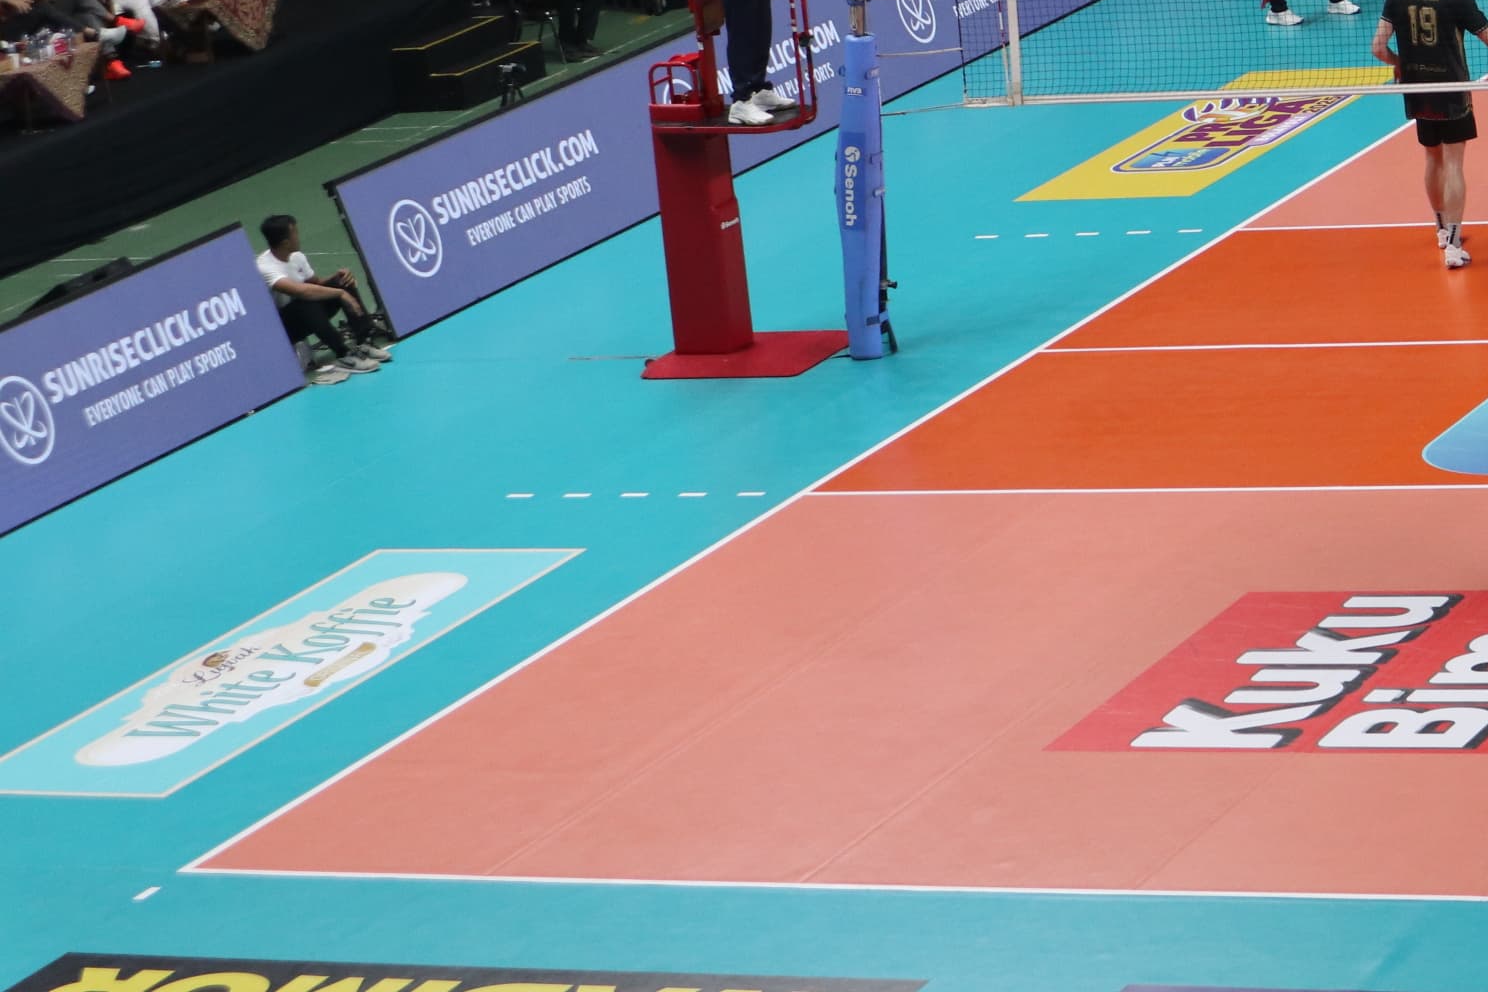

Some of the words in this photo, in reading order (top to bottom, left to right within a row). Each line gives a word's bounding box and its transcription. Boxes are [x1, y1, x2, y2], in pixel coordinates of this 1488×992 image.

[1407, 5, 1438, 46] 19
[1203, 98, 1323, 147] LIGA
[431, 129, 600, 225] SUNRISECLICK.COM
[466, 211, 517, 247] EVERYONE
[515, 204, 536, 225] CAN
[535, 192, 556, 216] PLAY
[556, 175, 592, 206] SPORTS
[844, 164, 858, 227] Senoh
[42, 288, 247, 404] SUNRISECLICK.COM
[84, 387, 145, 428] EVERYONE
[144, 374, 169, 400] CAN
[168, 358, 196, 390] PLAY
[196, 340, 238, 375] SPORTS
[123, 669, 297, 738] White
[262, 596, 417, 665] Koffie
[1129, 593, 1462, 749] Kuku
